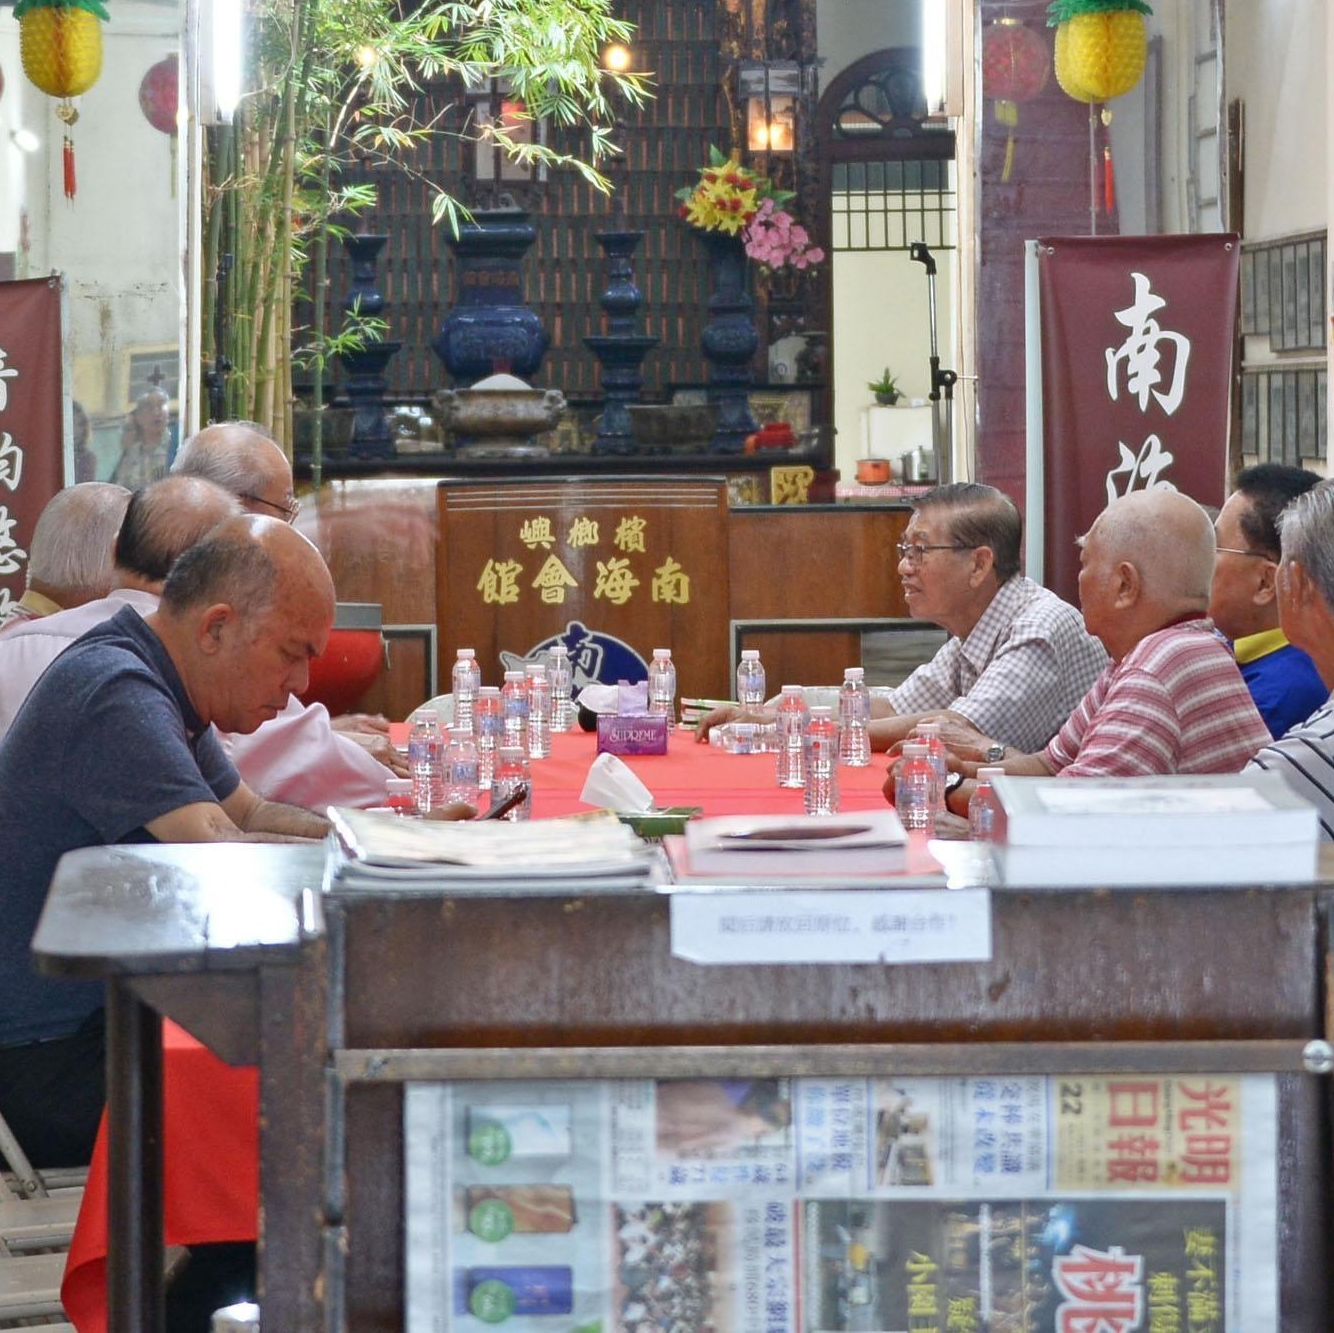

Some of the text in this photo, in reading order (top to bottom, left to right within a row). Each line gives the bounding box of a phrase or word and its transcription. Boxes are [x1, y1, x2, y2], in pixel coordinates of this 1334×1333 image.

[520, 515, 647, 553] 檳榔嶼
[477, 553, 690, 605] 南海會館
[609, 729, 657, 743] SUPREME
[1059, 1082, 1082, 1115] 22
[1106, 1082, 1158, 1183] 日報
[1177, 1081, 1232, 1183] 光明
